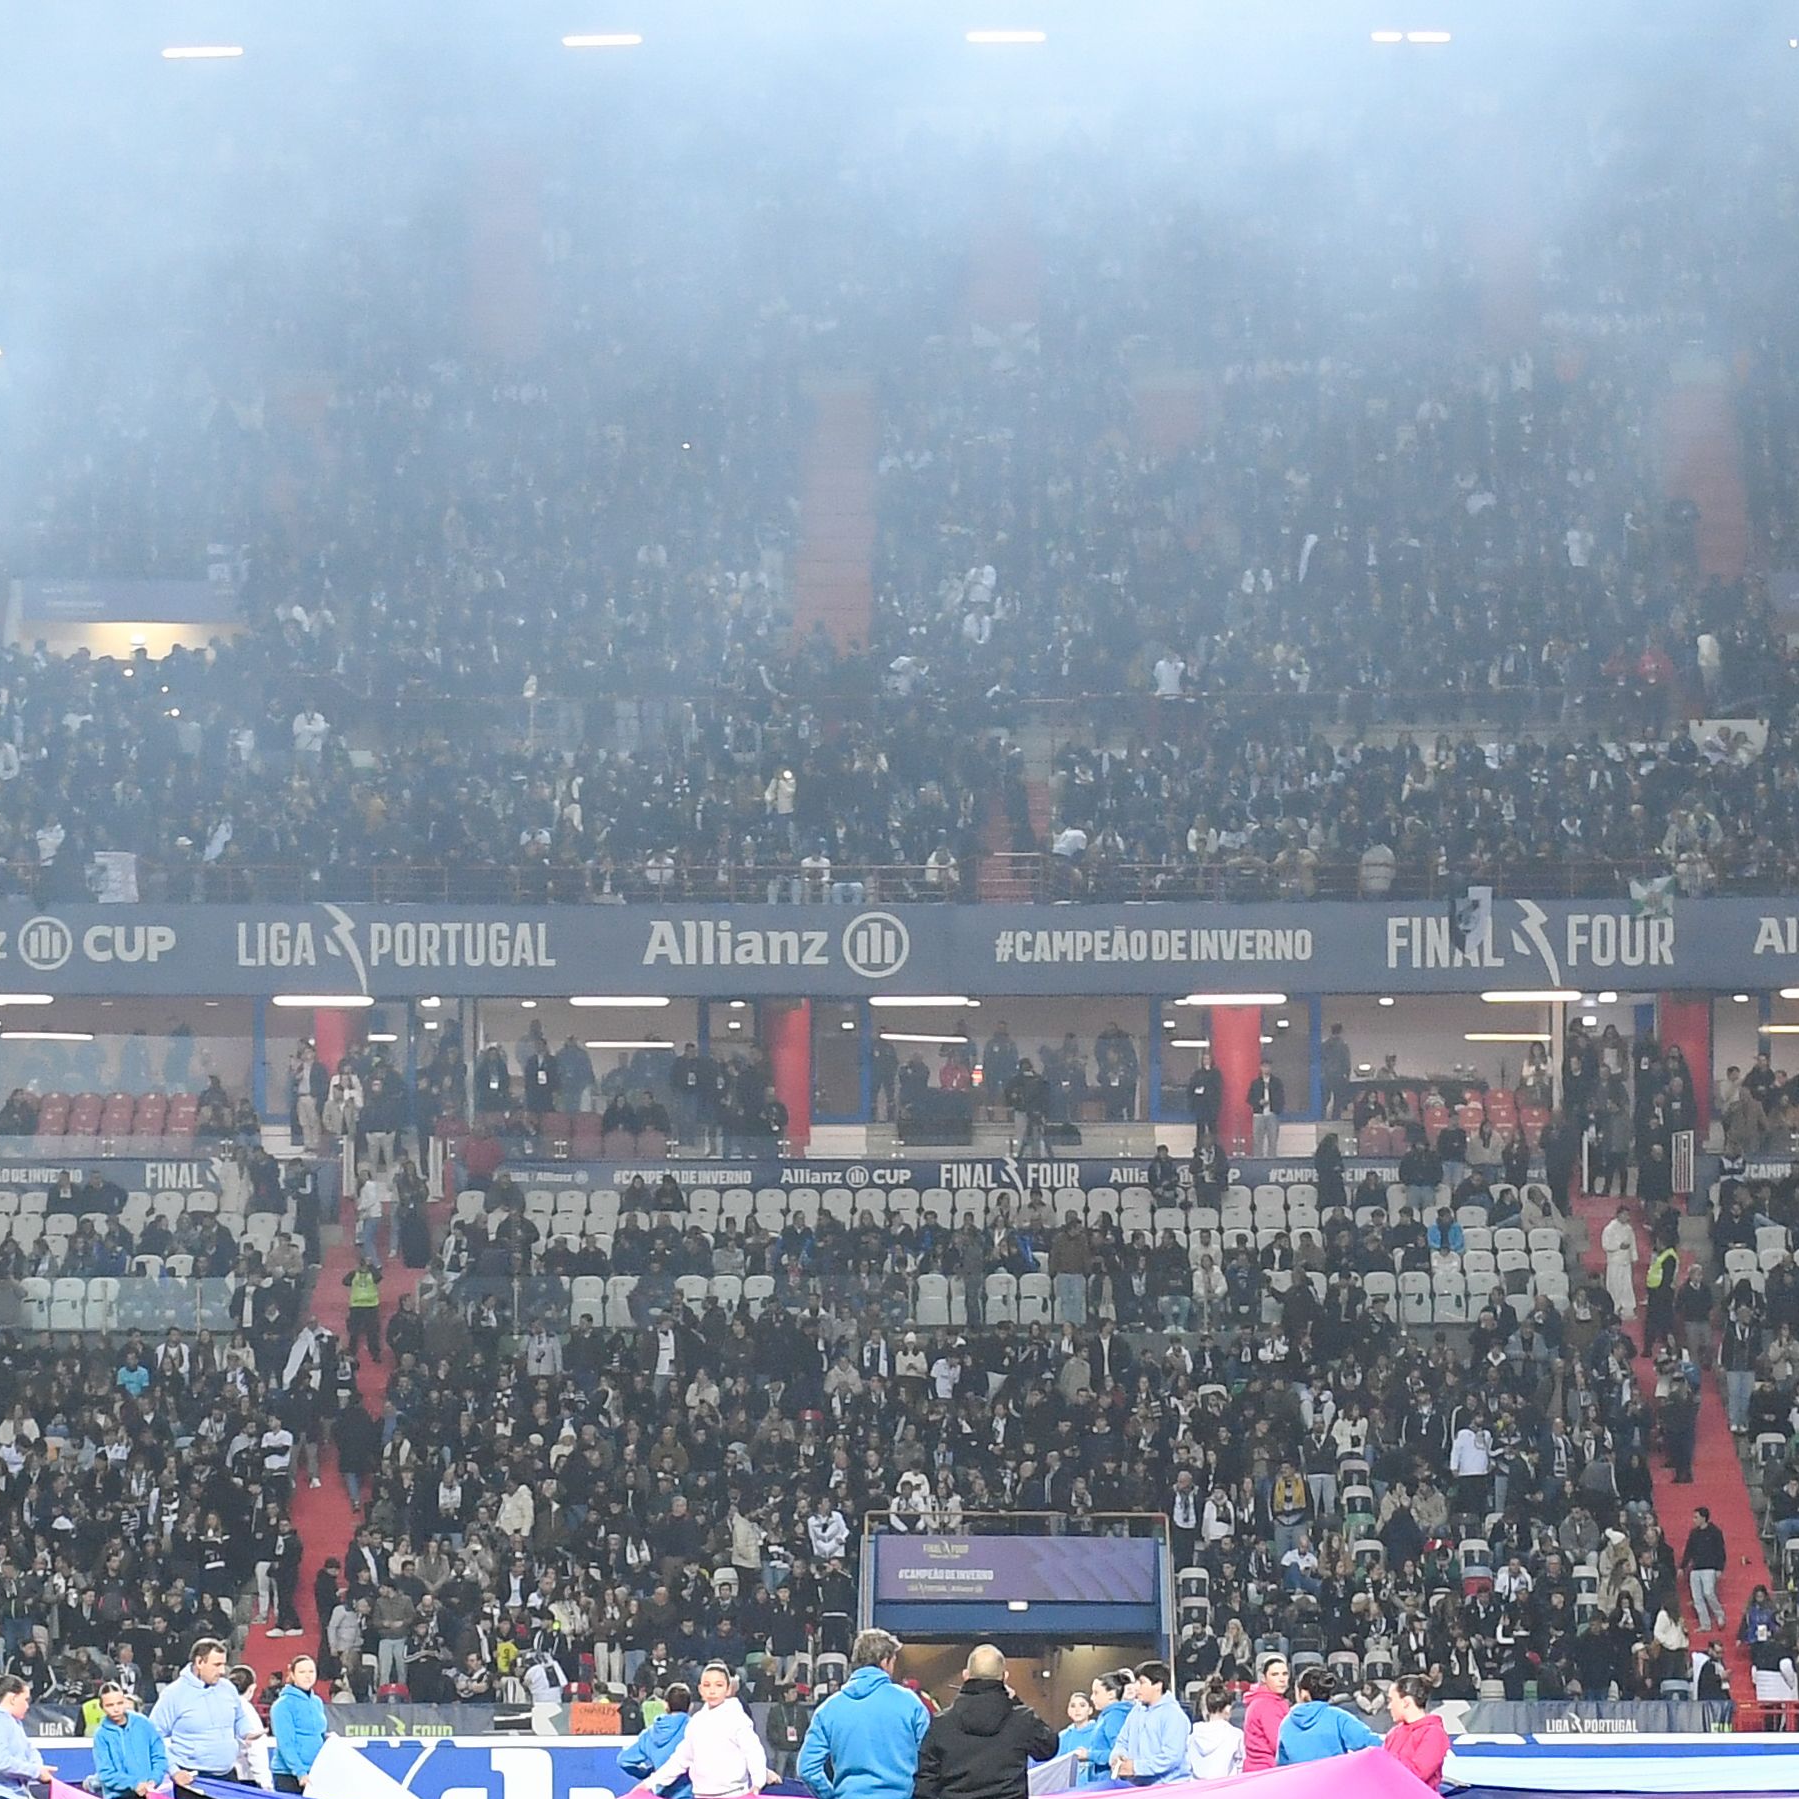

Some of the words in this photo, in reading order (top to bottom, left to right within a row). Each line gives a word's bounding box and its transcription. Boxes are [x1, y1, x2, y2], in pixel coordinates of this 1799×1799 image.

[83, 926, 176, 963] CUP
[238, 921, 315, 966] LIGA
[370, 921, 555, 967] PORTUGAL
[643, 919, 828, 965] Allianz
[1566, 914, 1674, 966] FOUR
[145, 1163, 203, 1188] FINAL
[780, 1169, 842, 1184] Allianz
[873, 1170, 911, 1184] CUP
[940, 1164, 997, 1188] FINAL
[1027, 1164, 1079, 1188] FOUR
[1546, 1719, 1569, 1731] LIGA
[1584, 1719, 1638, 1731] PORTUGAL
